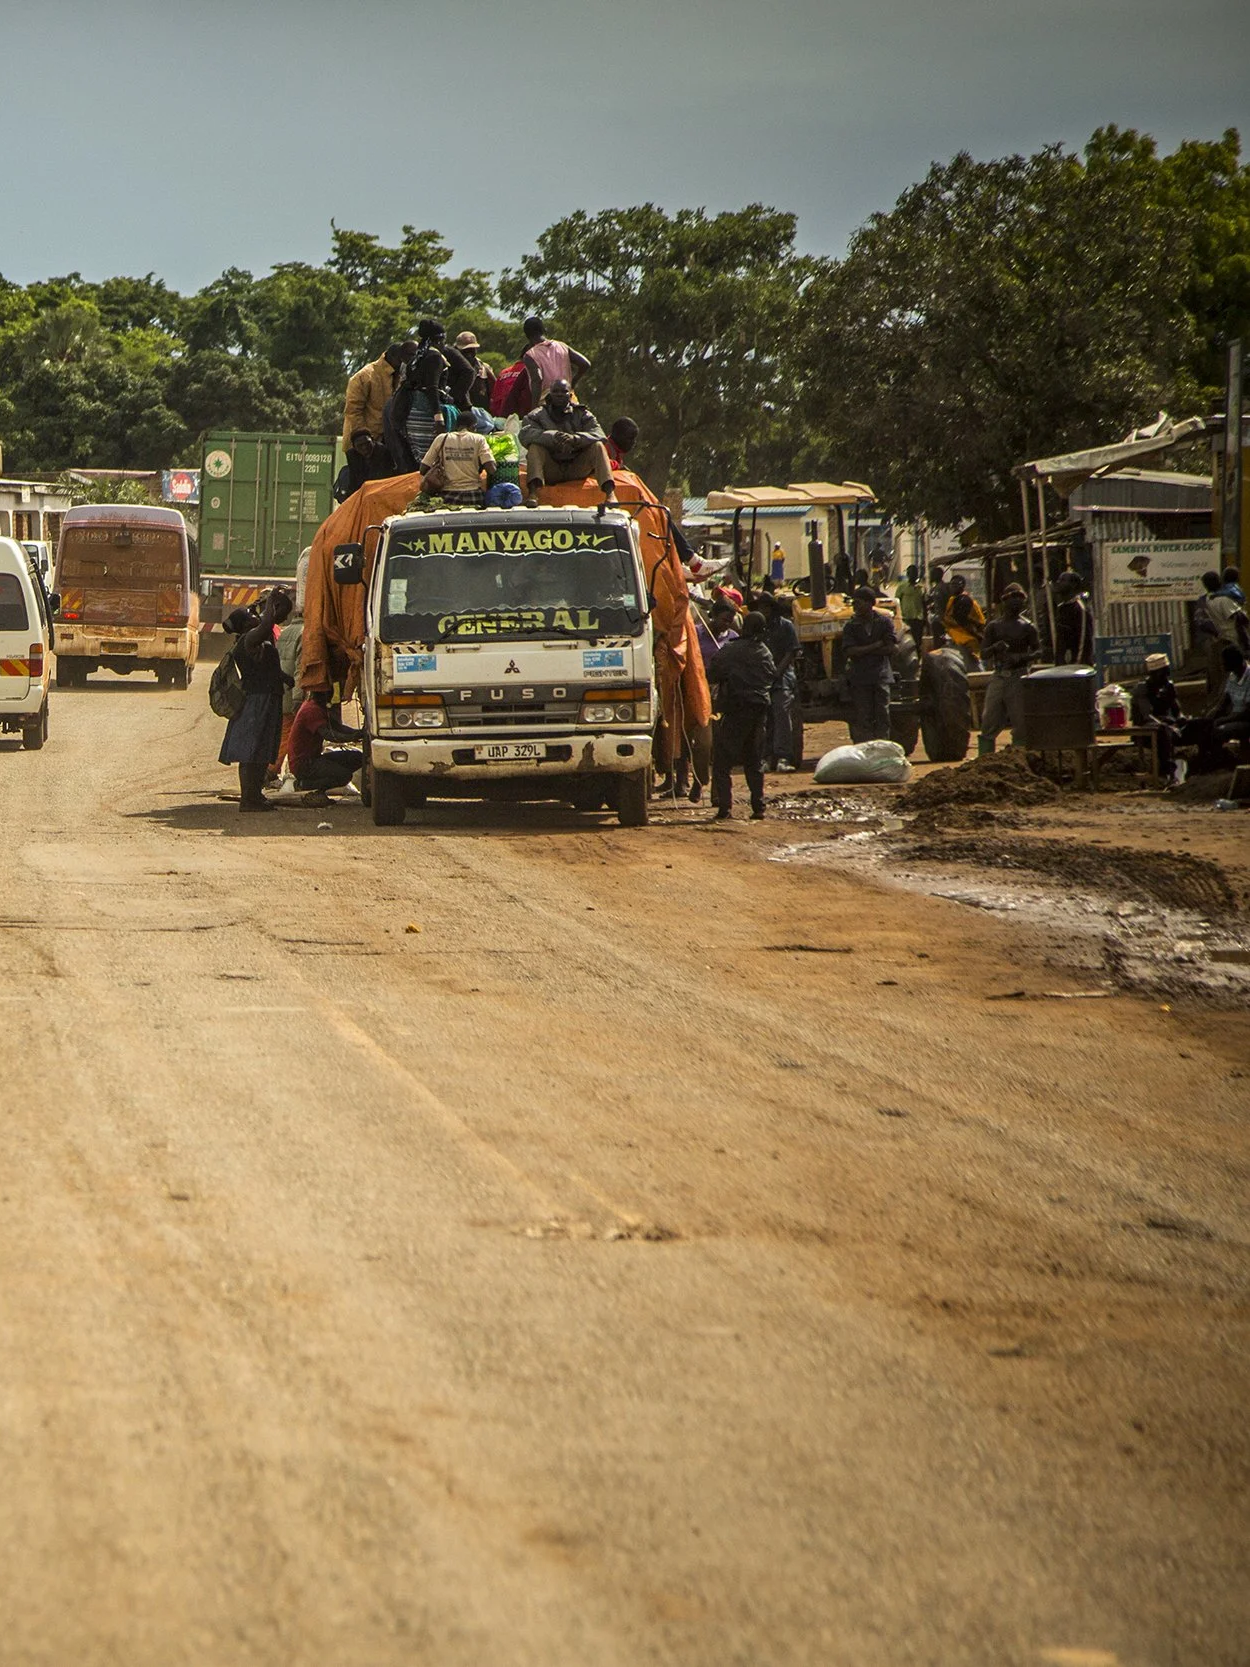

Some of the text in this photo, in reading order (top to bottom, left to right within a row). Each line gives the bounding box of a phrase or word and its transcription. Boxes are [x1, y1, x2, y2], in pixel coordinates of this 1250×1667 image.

[428, 529, 574, 554] MANYAGO
[1153, 544, 1181, 552] RIVER
[1183, 543, 1214, 551] LODGE
[437, 609, 600, 635] GENERAL
[583, 669, 628, 678] FIGHTER
[460, 687, 567, 701] FUSO
[487, 744, 541, 758] UAP 329L
